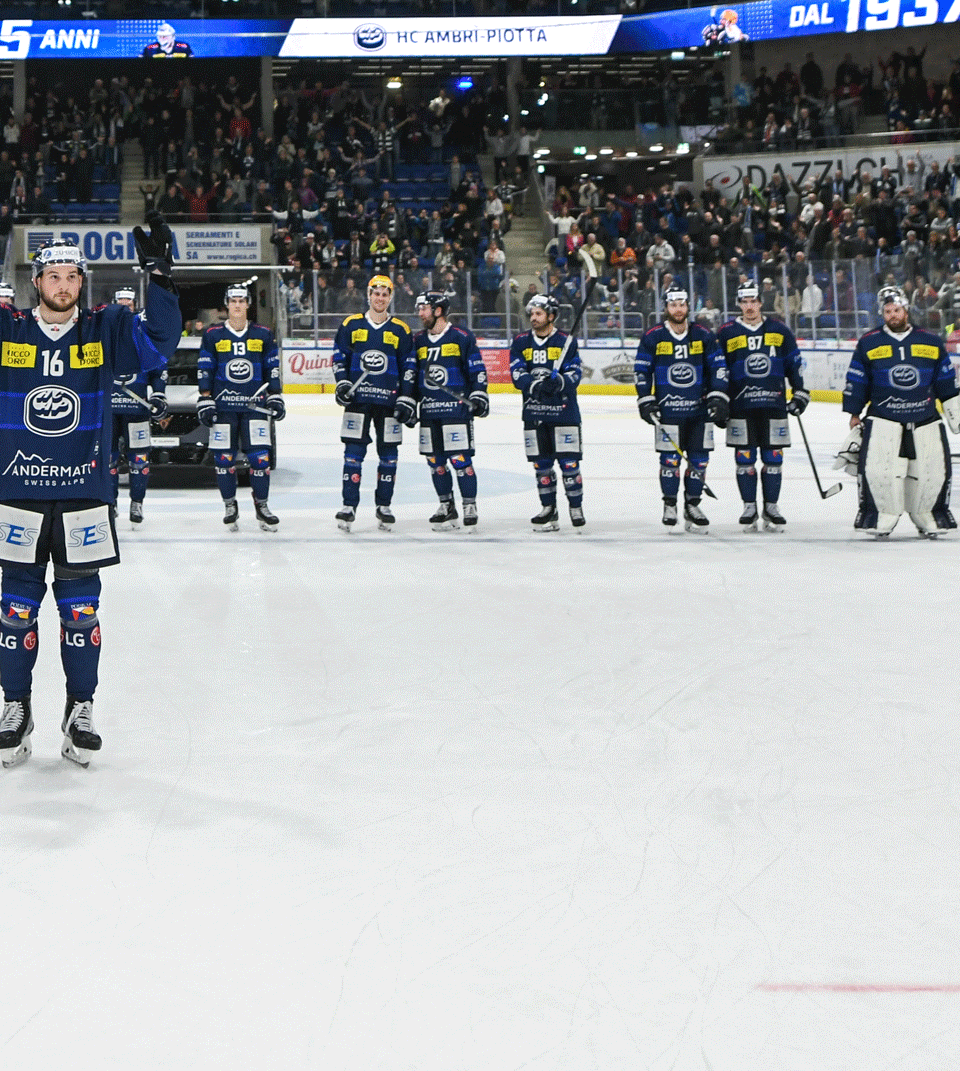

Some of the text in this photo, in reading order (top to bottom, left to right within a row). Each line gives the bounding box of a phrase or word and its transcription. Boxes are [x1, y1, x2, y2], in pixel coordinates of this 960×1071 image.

[789, 2, 834, 28] DAL
[40, 29, 100, 49] ANNI
[397, 30, 418, 43] HC
[60, 231, 240, 260] ROGI SERRAMENTI E
[185, 251, 257, 261] SA www.rogica.ch
[232, 342, 246, 355] 13
[747, 336, 762, 350] 87
[427, 347, 441, 362] 77
[533, 349, 547, 364] 88
[675, 344, 688, 359] 21
[898, 346, 905, 361] 1
[41, 349, 64, 377] 16
[61, 478, 85, 486] ALPS
[67, 520, 108, 548] SES
[0, 631, 17, 650] LG
[65, 631, 85, 647] LG
